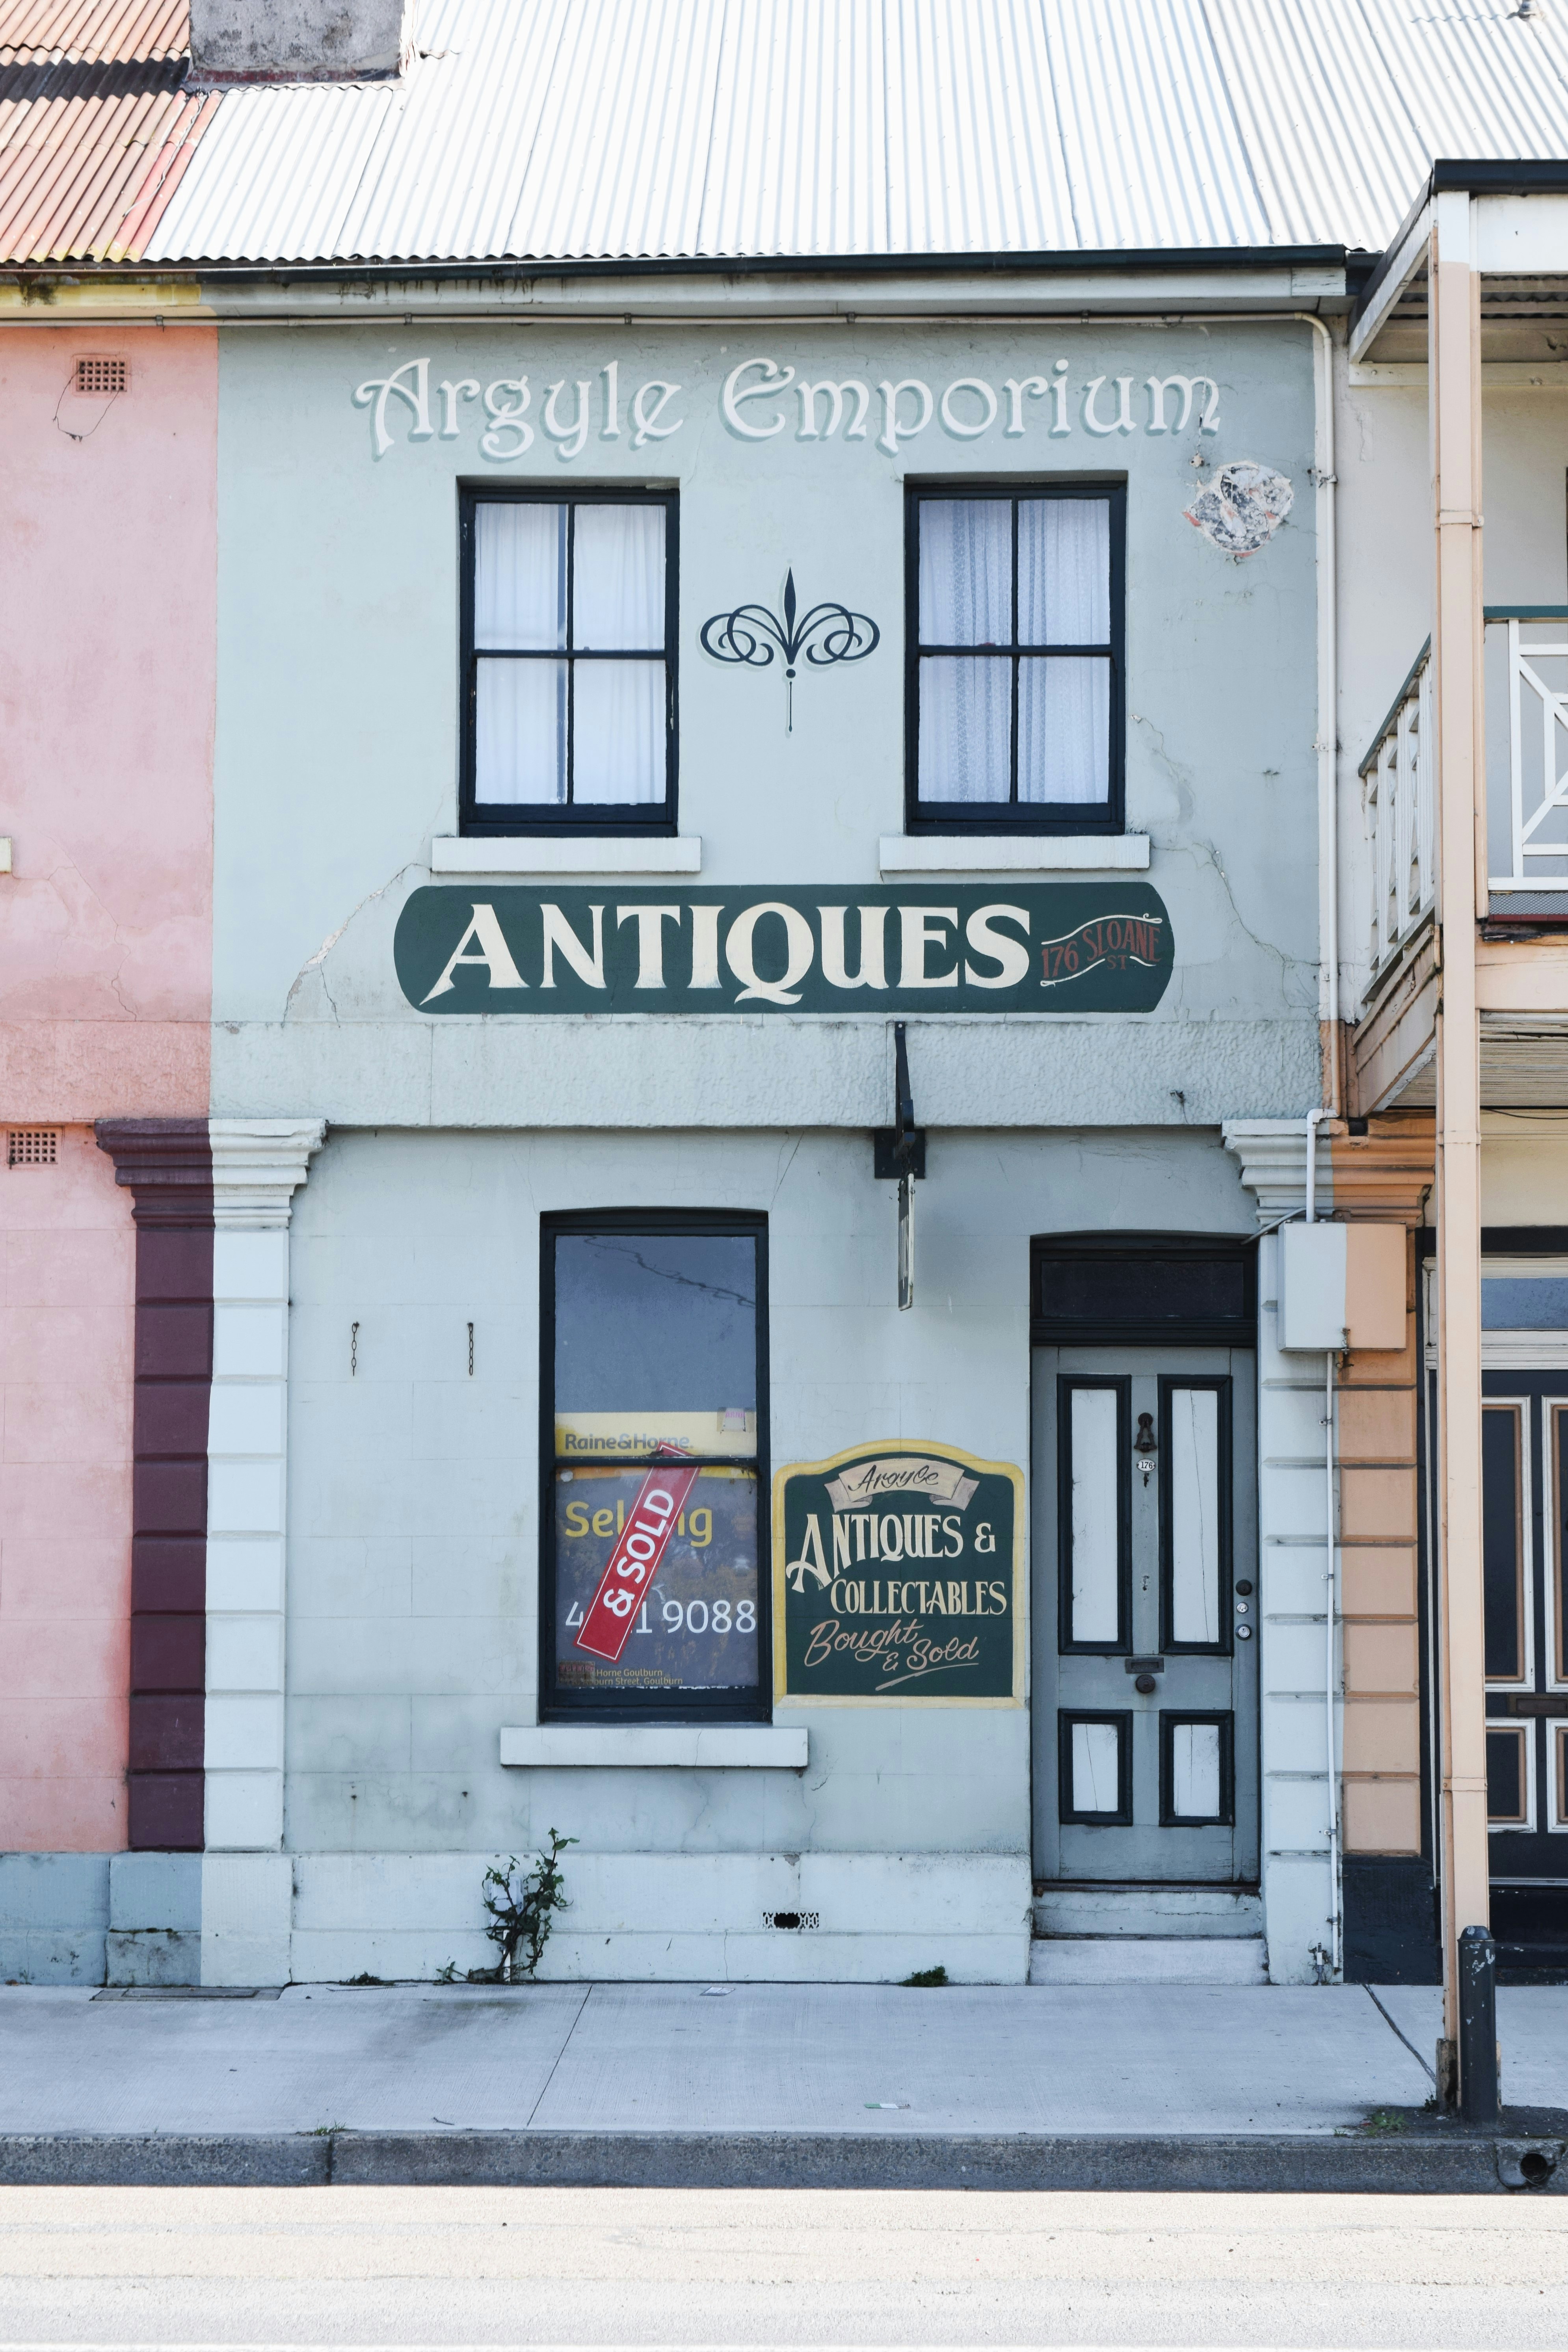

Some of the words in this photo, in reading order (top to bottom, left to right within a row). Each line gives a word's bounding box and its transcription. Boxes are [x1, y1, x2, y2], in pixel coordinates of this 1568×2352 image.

[353, 357, 684, 462] Argyle
[719, 358, 1221, 458] Emporium
[419, 902, 1030, 1005] ANTIQUES
[1042, 941, 1079, 978] 176
[1083, 920, 1161, 962] SLOANE
[1107, 955, 1128, 970] ST
[848, 1465, 938, 1493] Argyle
[617, 1489, 674, 1584] SOLD
[786, 1513, 963, 1593] ANTIQUES
[974, 1523, 996, 1553] &
[603, 1588, 635, 1617] &
[830, 1579, 1007, 1615] COLLECTABLES
[662, 1600, 756, 1634] 9088
[804, 1618, 924, 1667] Bought
[882, 1652, 899, 1672] &
[906, 1636, 979, 1670] Sold
[615, 1676, 642, 1686] Street,
[644, 1676, 683, 1686] Goulburn
[624, 1668, 663, 1677] Goulburn
